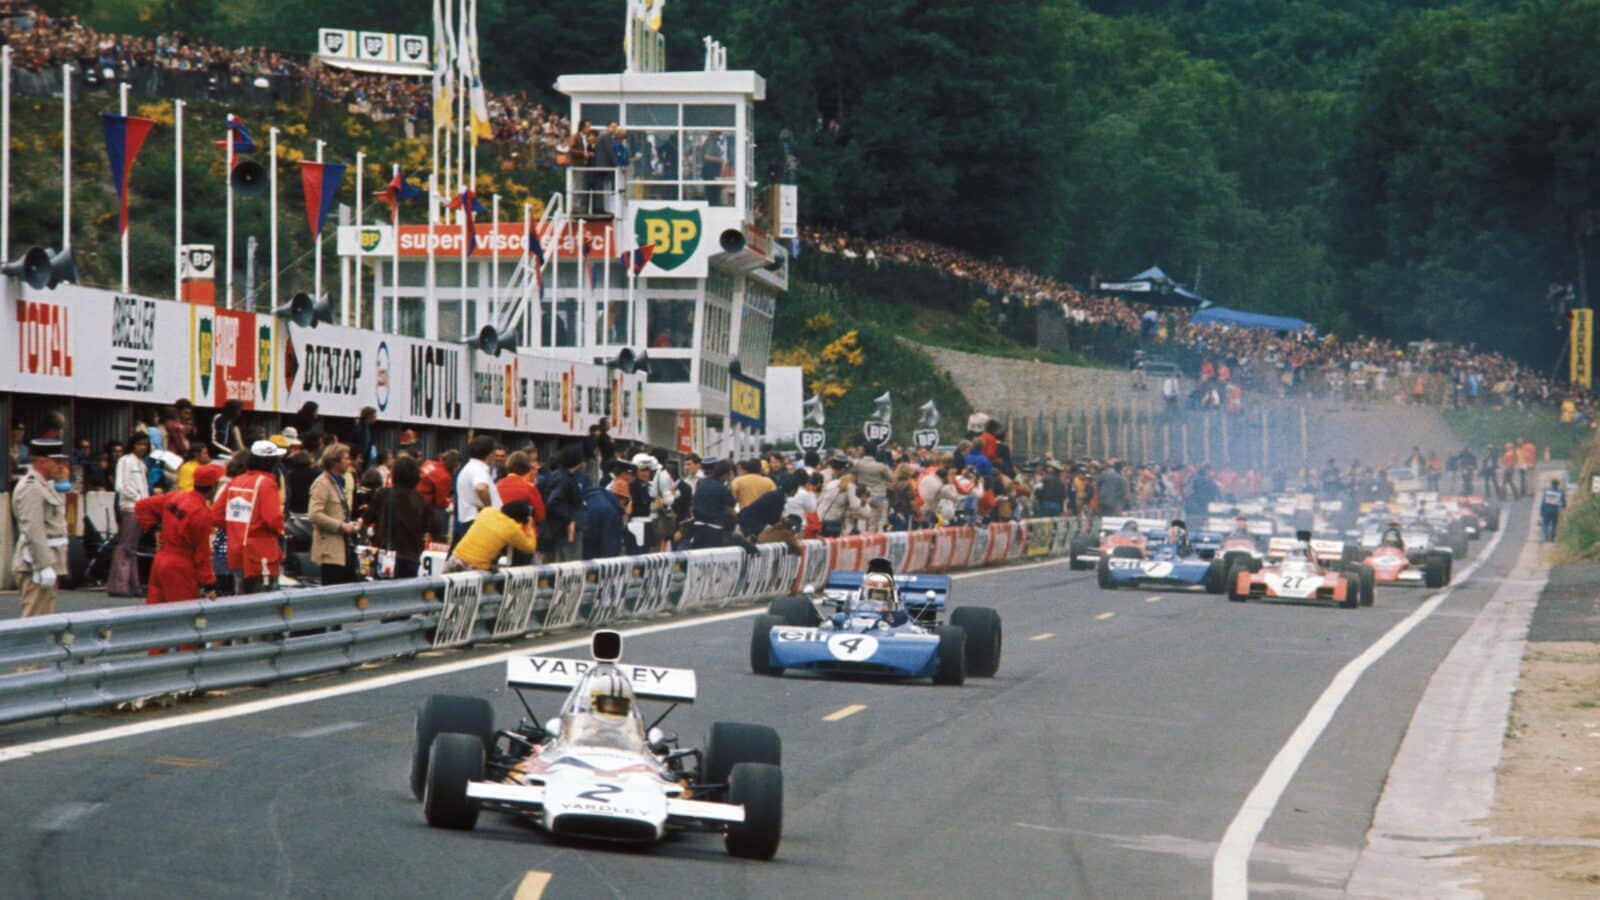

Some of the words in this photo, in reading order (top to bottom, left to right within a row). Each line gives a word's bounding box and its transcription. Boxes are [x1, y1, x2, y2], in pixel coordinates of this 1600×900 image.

[326, 36, 343, 49] BP
[406, 40, 423, 52] BP
[360, 232, 379, 247] BP
[644, 218, 697, 255] BP
[192, 252, 212, 267] BP
[16, 299, 72, 377] TOTAL
[303, 343, 362, 395] DUNLOP
[411, 344, 461, 420] MOTUL
[801, 432, 821, 448] BP
[870, 425, 889, 440] BP
[918, 434, 937, 447] BP
[423, 556, 433, 576] 9
[1282, 576, 1304, 589] 27
[838, 637, 864, 654] 4
[529, 658, 668, 683] YAREY
[576, 783, 624, 803] 2
[560, 803, 649, 816] YARDLEY
